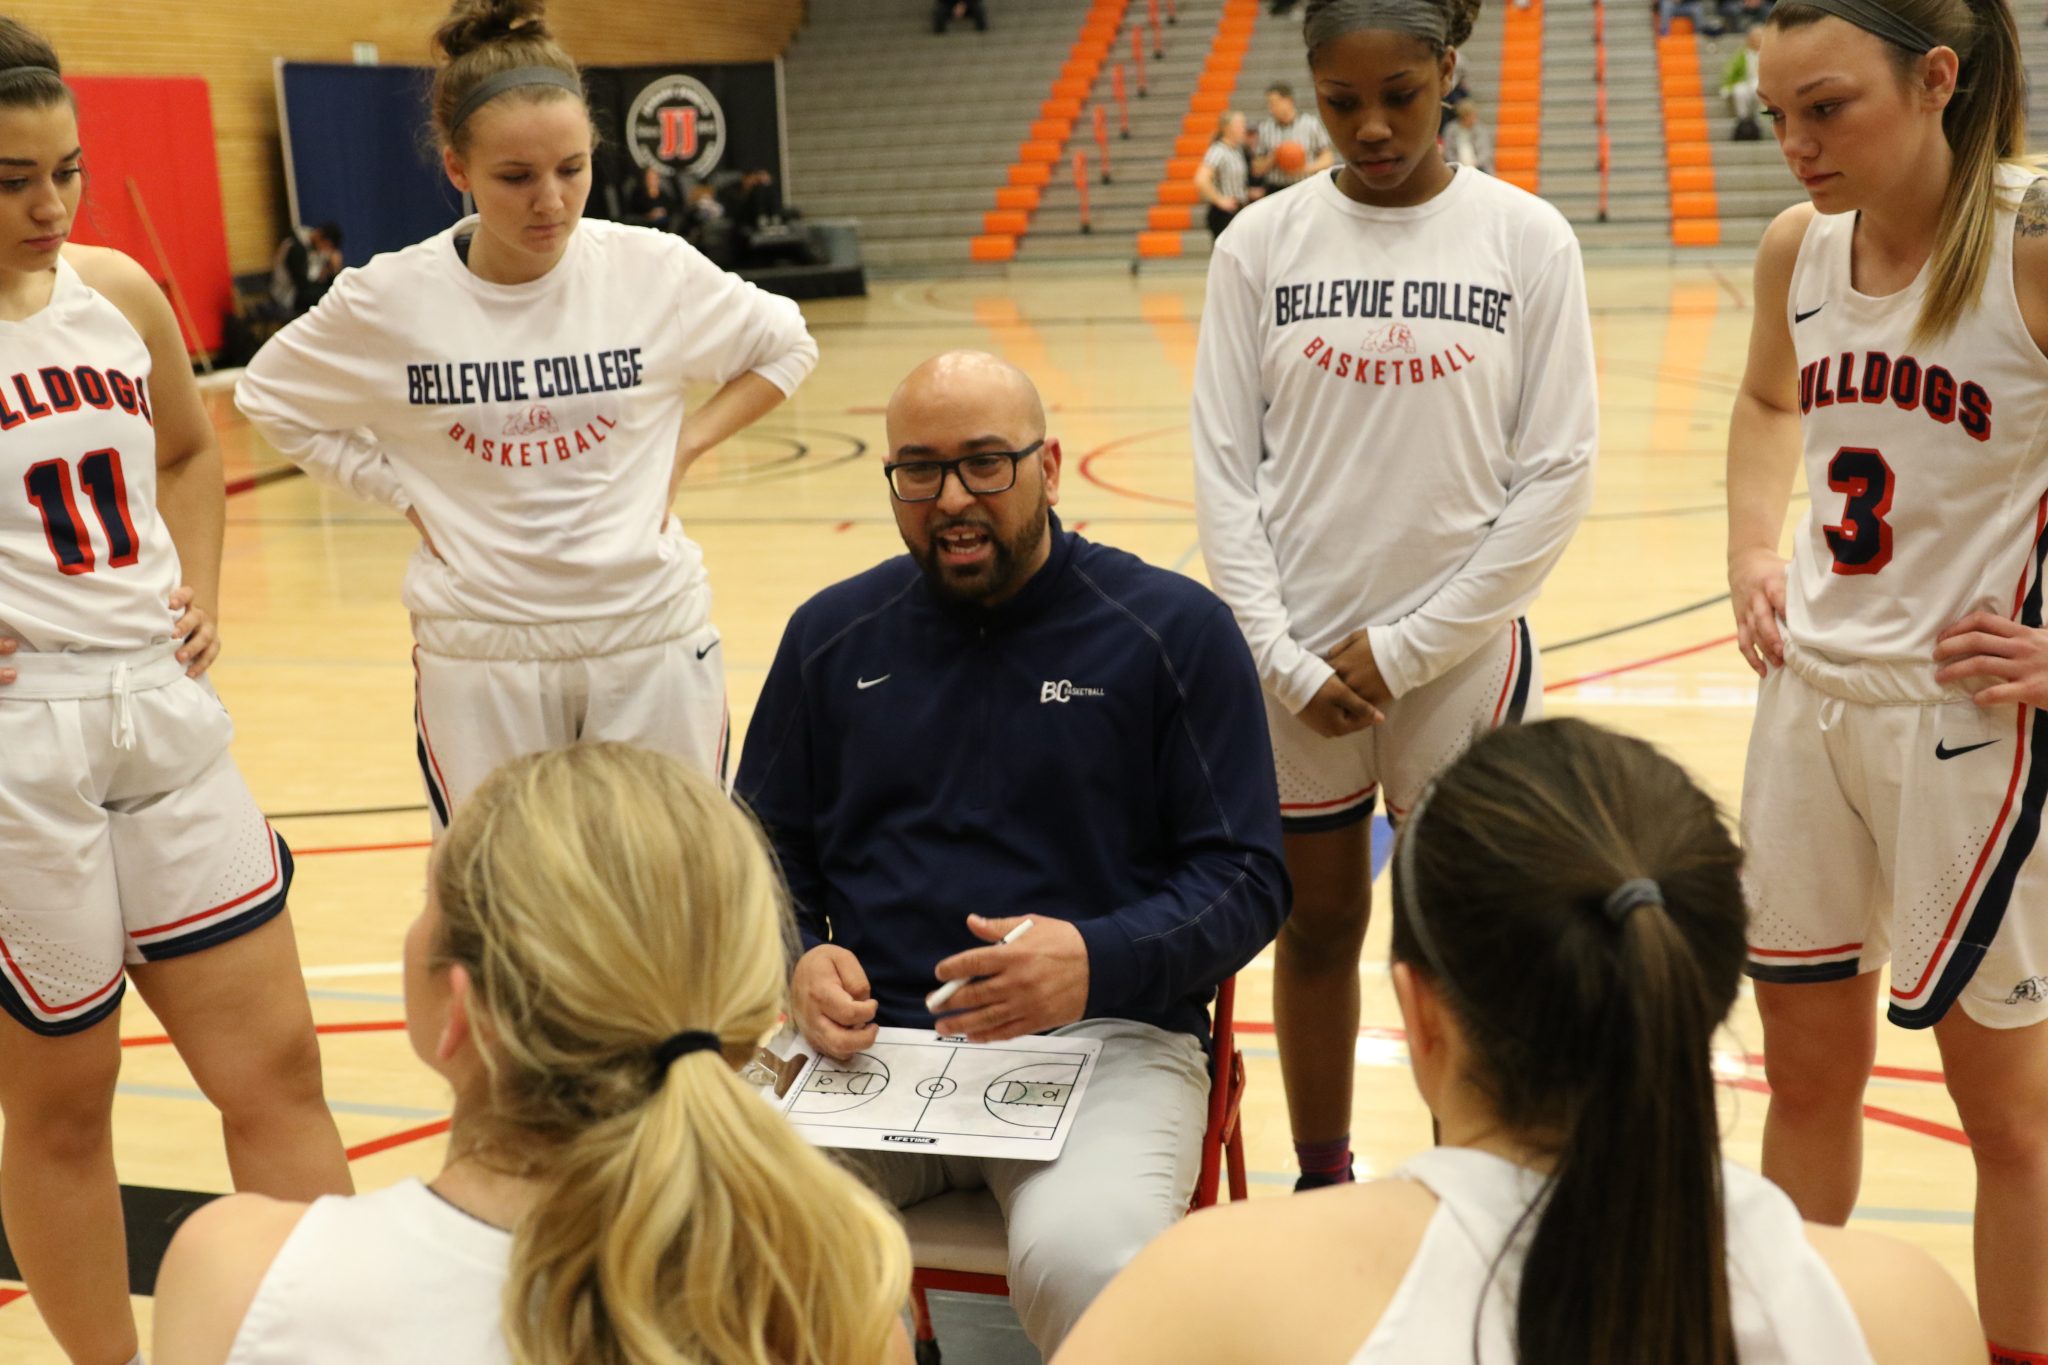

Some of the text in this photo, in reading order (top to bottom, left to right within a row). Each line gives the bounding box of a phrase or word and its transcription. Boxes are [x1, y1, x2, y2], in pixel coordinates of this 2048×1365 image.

[1275, 279, 1512, 334] BELLEVUE COLLEGE
[407, 348, 643, 404] BELLEVUE COLLEGE
[1303, 336, 1476, 385] BASKETBALL
[1798, 351, 1992, 442] ULLDOGS
[448, 414, 617, 467] BASKETBALL
[23, 447, 140, 576] 11
[1822, 446, 1896, 576] 3
[1040, 679, 1072, 703] BC
[888, 1135, 931, 1143] LIFETIME
